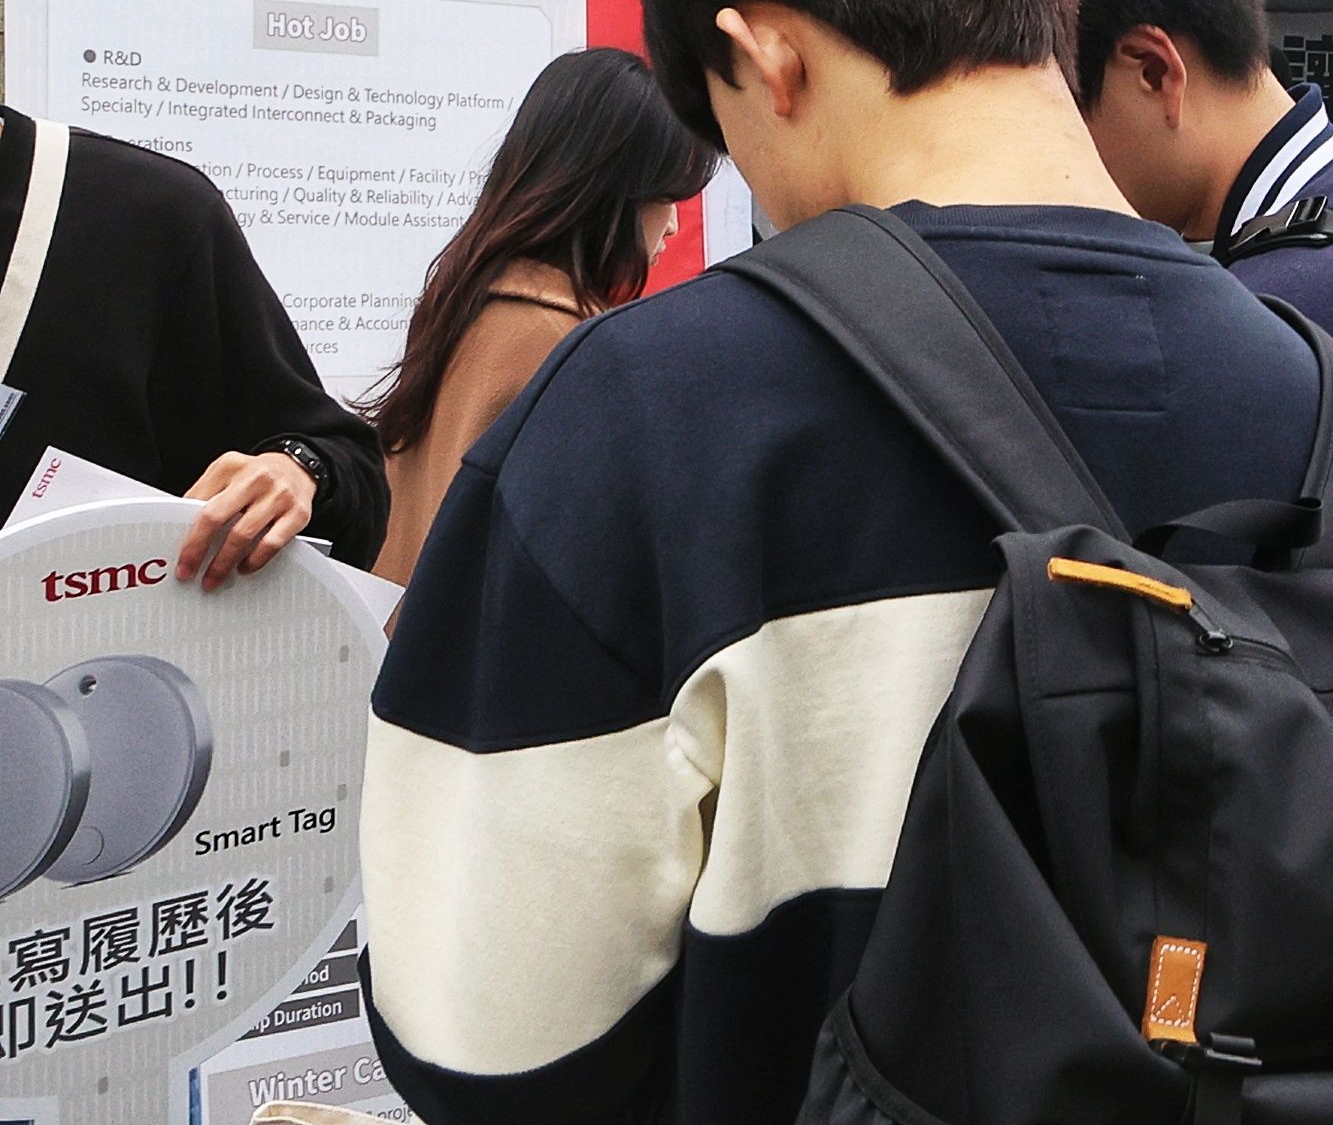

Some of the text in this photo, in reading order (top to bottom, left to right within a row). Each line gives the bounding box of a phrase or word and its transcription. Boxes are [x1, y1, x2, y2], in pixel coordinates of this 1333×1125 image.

[267, 12, 367, 44] Hot Job
[103, 49, 142, 68] R&D
[82, 73, 151, 90] Research
[157, 77, 171, 92] &
[176, 78, 278, 98] Development
[293, 85, 343, 104] Design
[347, 87, 360, 102] &
[364, 88, 444, 110] Technology
[448, 93, 504, 109] Platform
[81, 97, 152, 117] Specialty
[168, 101, 247, 120] Integrated
[252, 105, 345, 123] Interconnect
[349, 109, 361, 124] &
[366, 110, 436, 131] Packaging
[128, 137, 193, 153] erations
[247, 164, 303, 180] Process
[318, 166, 395, 185] Equipment
[410, 169, 456, 188] Facility
[225, 188, 278, 205] cturing
[294, 188, 345, 207] Quality
[350, 189, 362, 204] &
[367, 190, 433, 209] Reliability
[447, 192, 479, 207] Adva
[260, 210, 273, 225] &
[277, 211, 330, 226] Service
[345, 212, 399, 227] Module
[403, 213, 465, 228] Assistant
[282, 293, 356, 311] Corporate
[294, 317, 409, 331] nance & Accoun
[32, 457, 62, 498] tsmc
[41, 558, 167, 603] tsmc
[195, 806, 337, 856] Smart Tag
[8, 877, 275, 993] 寫履歷後
[275, 1000, 342, 1024] Duration
[248, 1055, 387, 1108] Winter Ca
